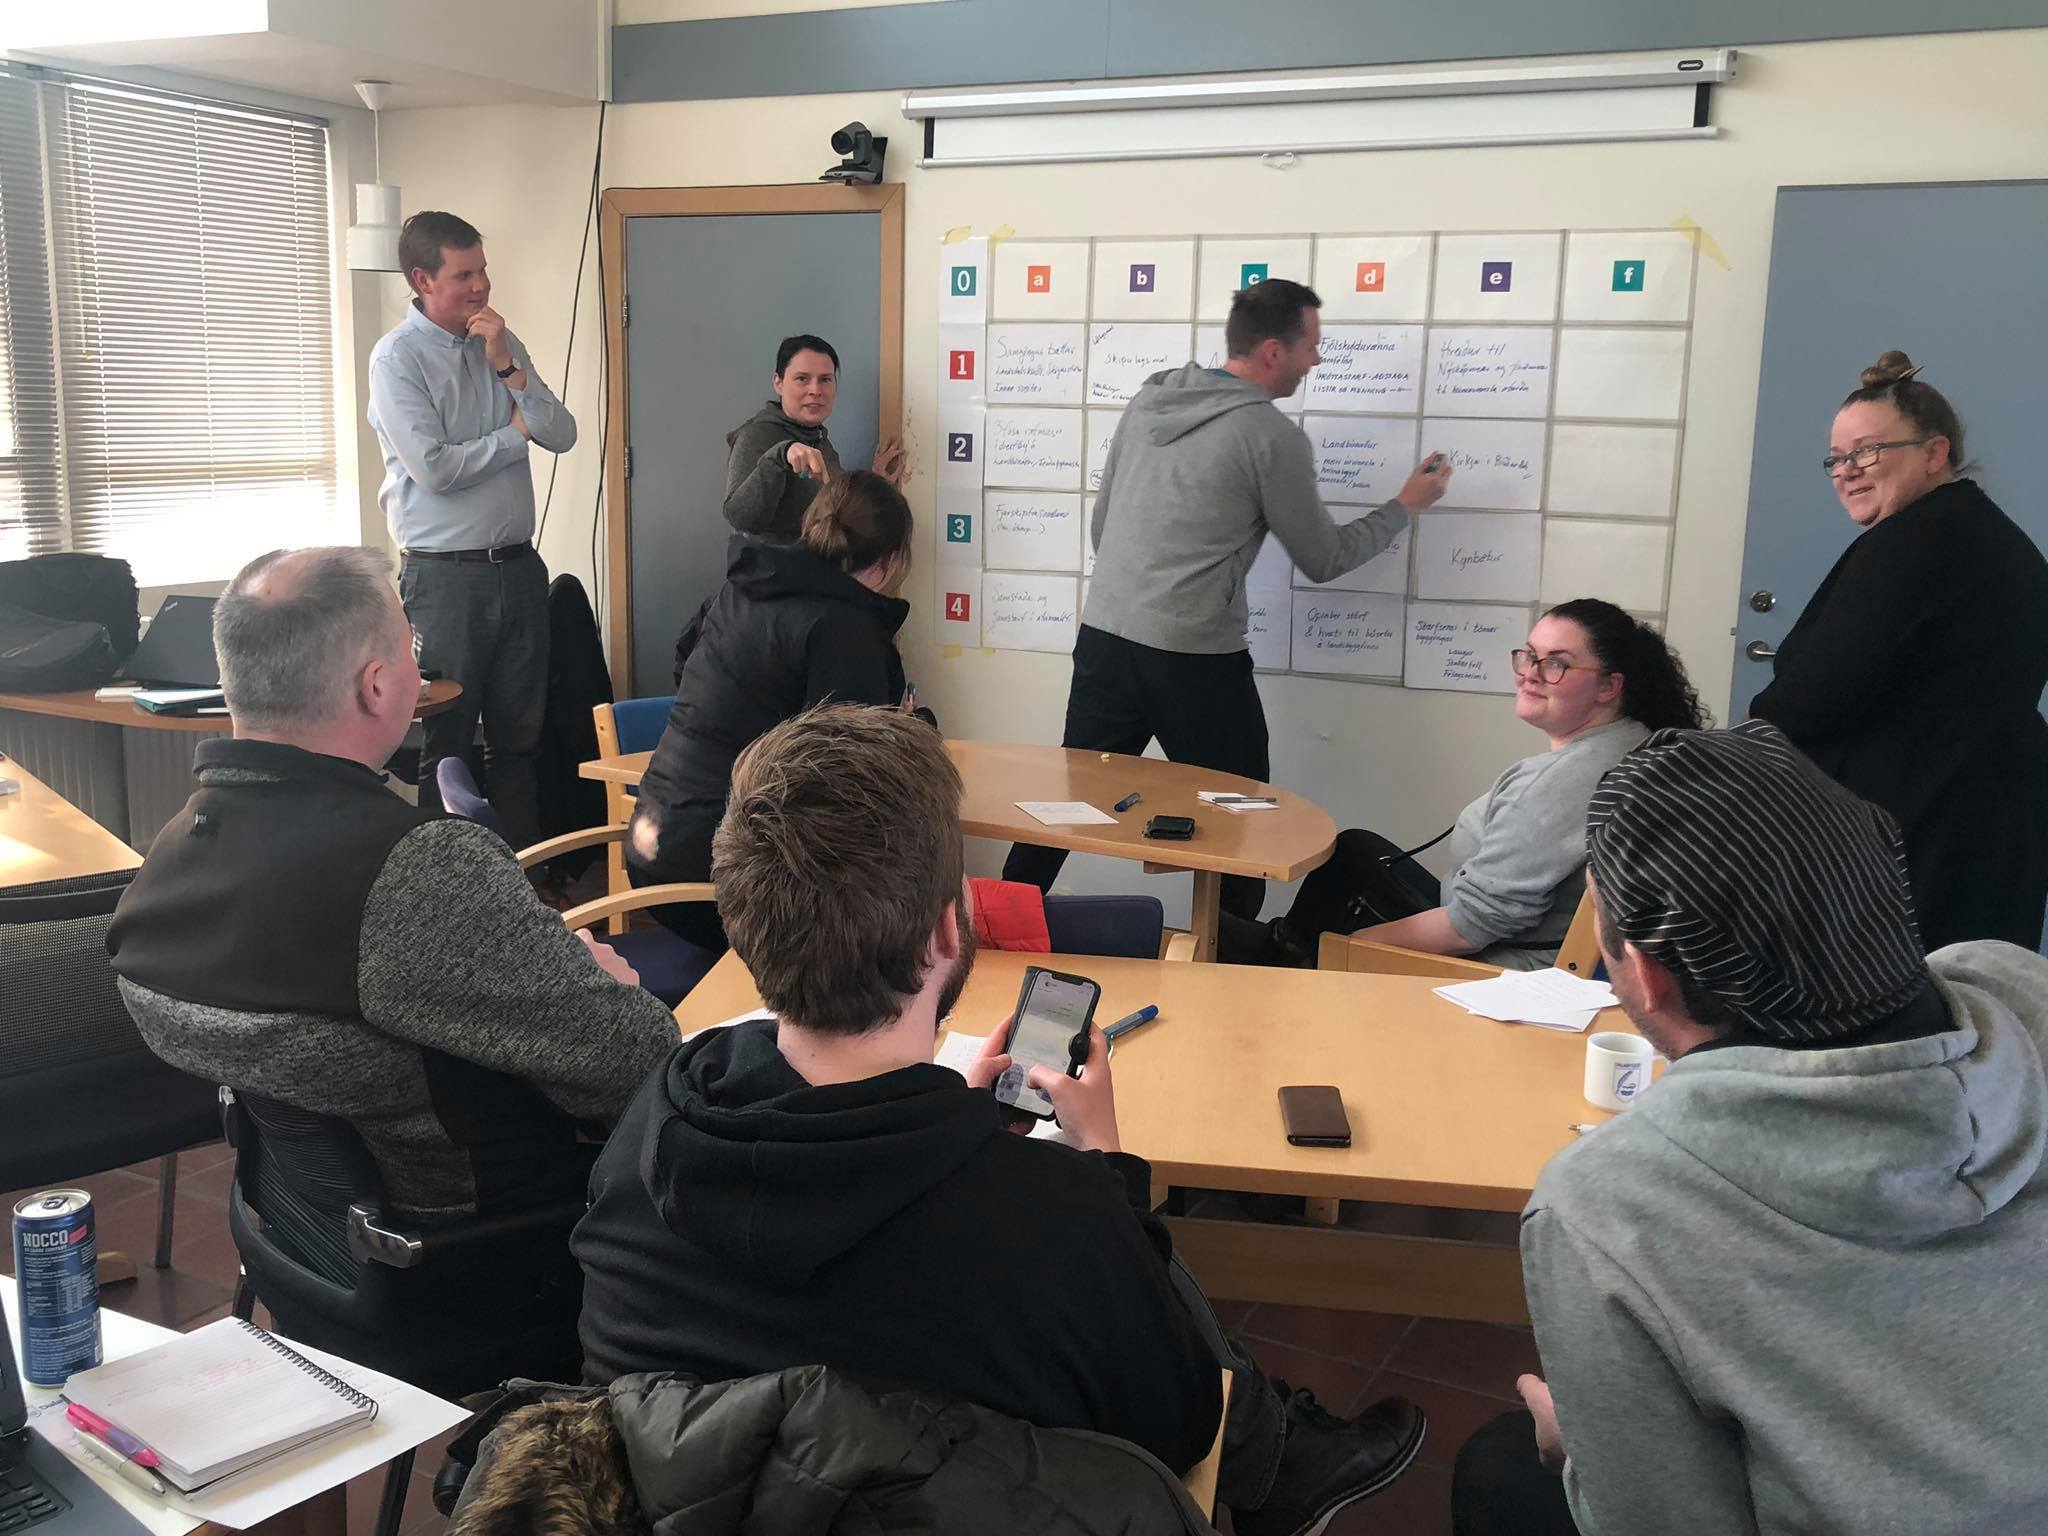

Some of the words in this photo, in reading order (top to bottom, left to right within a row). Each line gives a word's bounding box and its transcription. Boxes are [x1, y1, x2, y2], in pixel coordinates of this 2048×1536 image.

[1033, 274, 1044, 286] a
[1136, 271, 1147, 286] b
[1248, 273, 1259, 285] c
[1363, 269, 1376, 284] d
[1489, 272, 1502, 284] e
[1623, 267, 1634, 283] f
[957, 354, 967, 375] 1
[954, 437, 967, 457] 2
[953, 519, 965, 538] 3
[951, 597, 963, 616] 4
[23, 1230, 68, 1248] NOCCO
